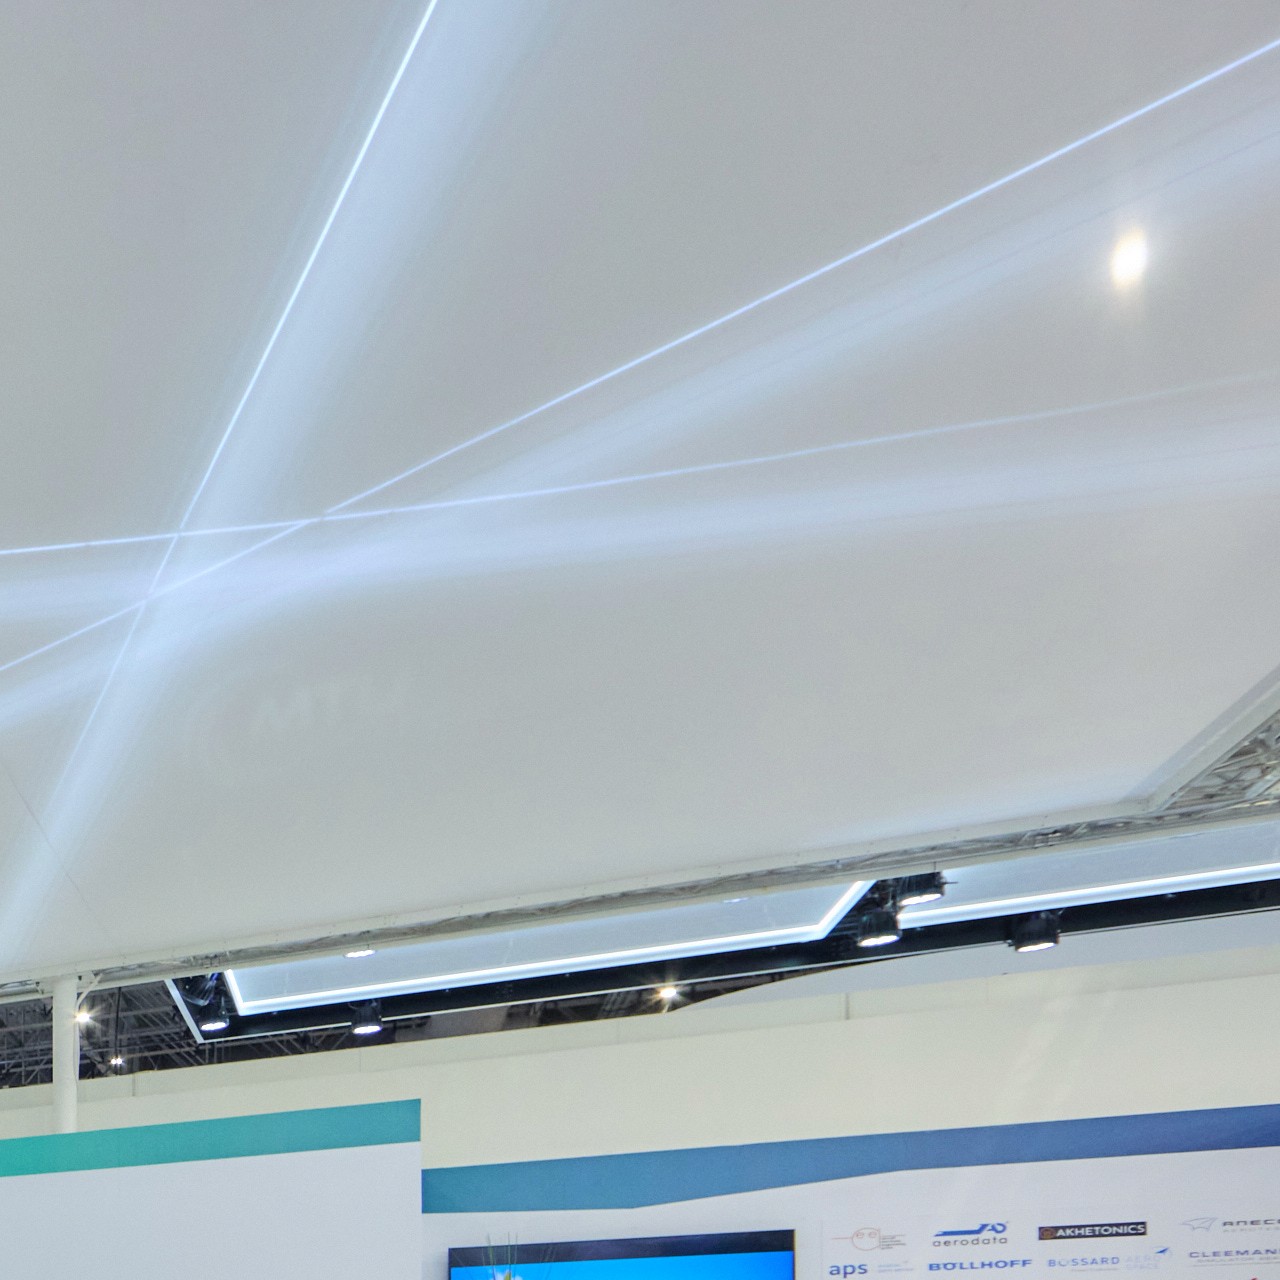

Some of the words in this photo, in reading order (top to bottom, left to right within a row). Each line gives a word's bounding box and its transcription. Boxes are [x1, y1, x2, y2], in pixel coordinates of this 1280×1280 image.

[1056, 1225, 1145, 1237] AKHETONICS
[932, 1237, 1008, 1247] aerodata
[1189, 1249, 1280, 1258] CLEEMAN
[829, 1264, 868, 1279] aps
